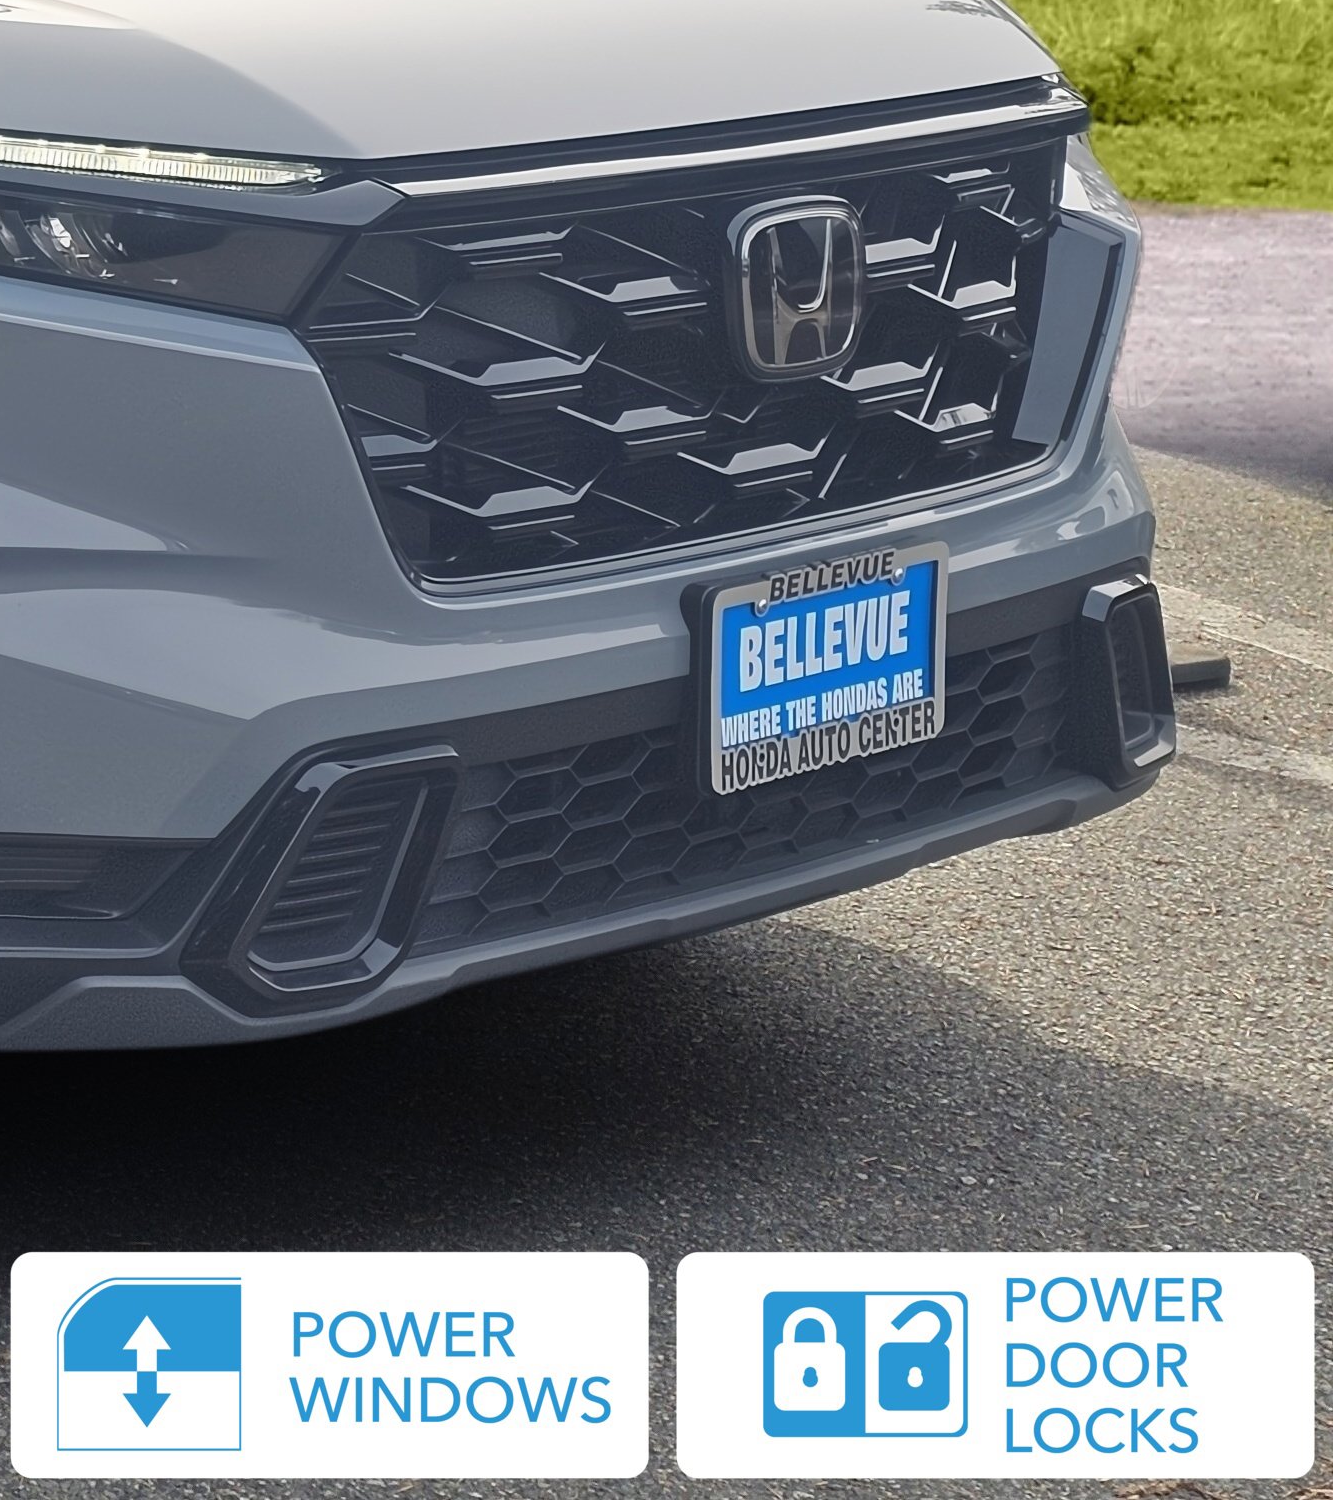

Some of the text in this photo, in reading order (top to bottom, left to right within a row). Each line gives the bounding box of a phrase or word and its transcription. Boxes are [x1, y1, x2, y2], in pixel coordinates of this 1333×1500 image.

[769, 551, 895, 602] BELLEVUE
[739, 589, 911, 693] BELLEVUE
[721, 667, 924, 748] WHERE THE HONDAS ARE
[721, 699, 935, 792] HONDA AUTO CENTER
